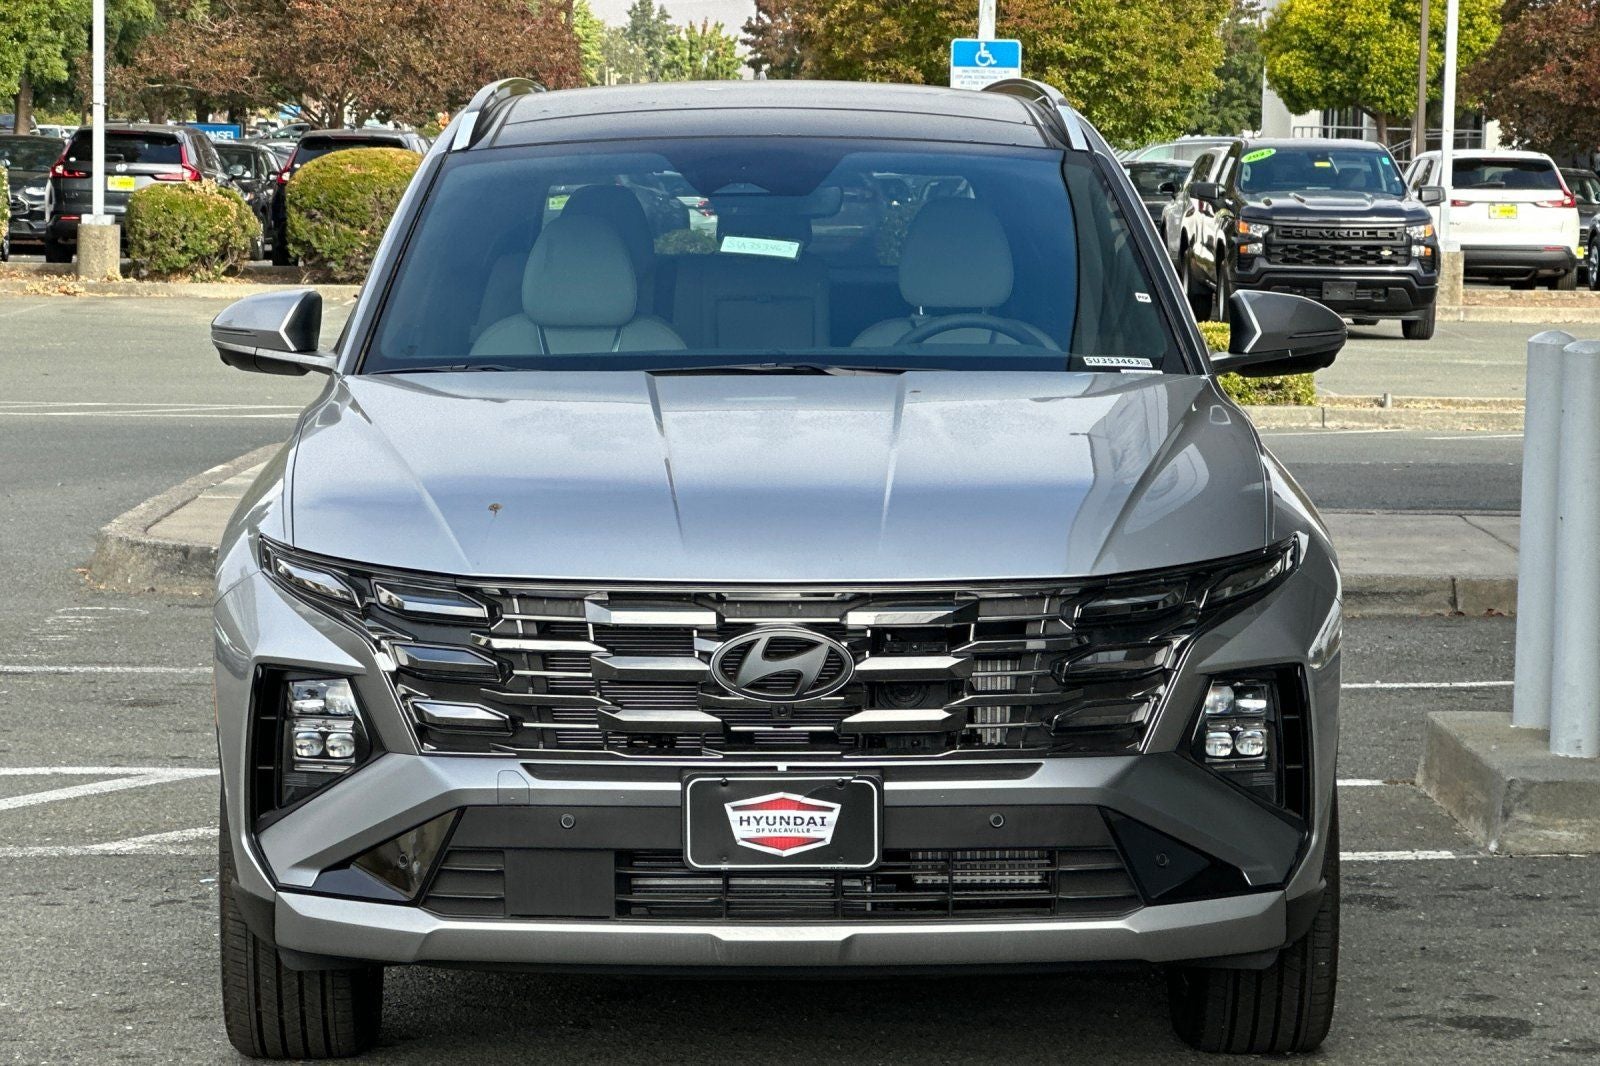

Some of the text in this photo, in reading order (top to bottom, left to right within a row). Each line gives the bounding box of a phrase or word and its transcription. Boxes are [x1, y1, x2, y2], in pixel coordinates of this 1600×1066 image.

[1279, 226, 1402, 239] CHEVROLET
[1085, 357, 1141, 365] SU353463
[739, 816, 827, 827] HYUNDAI
